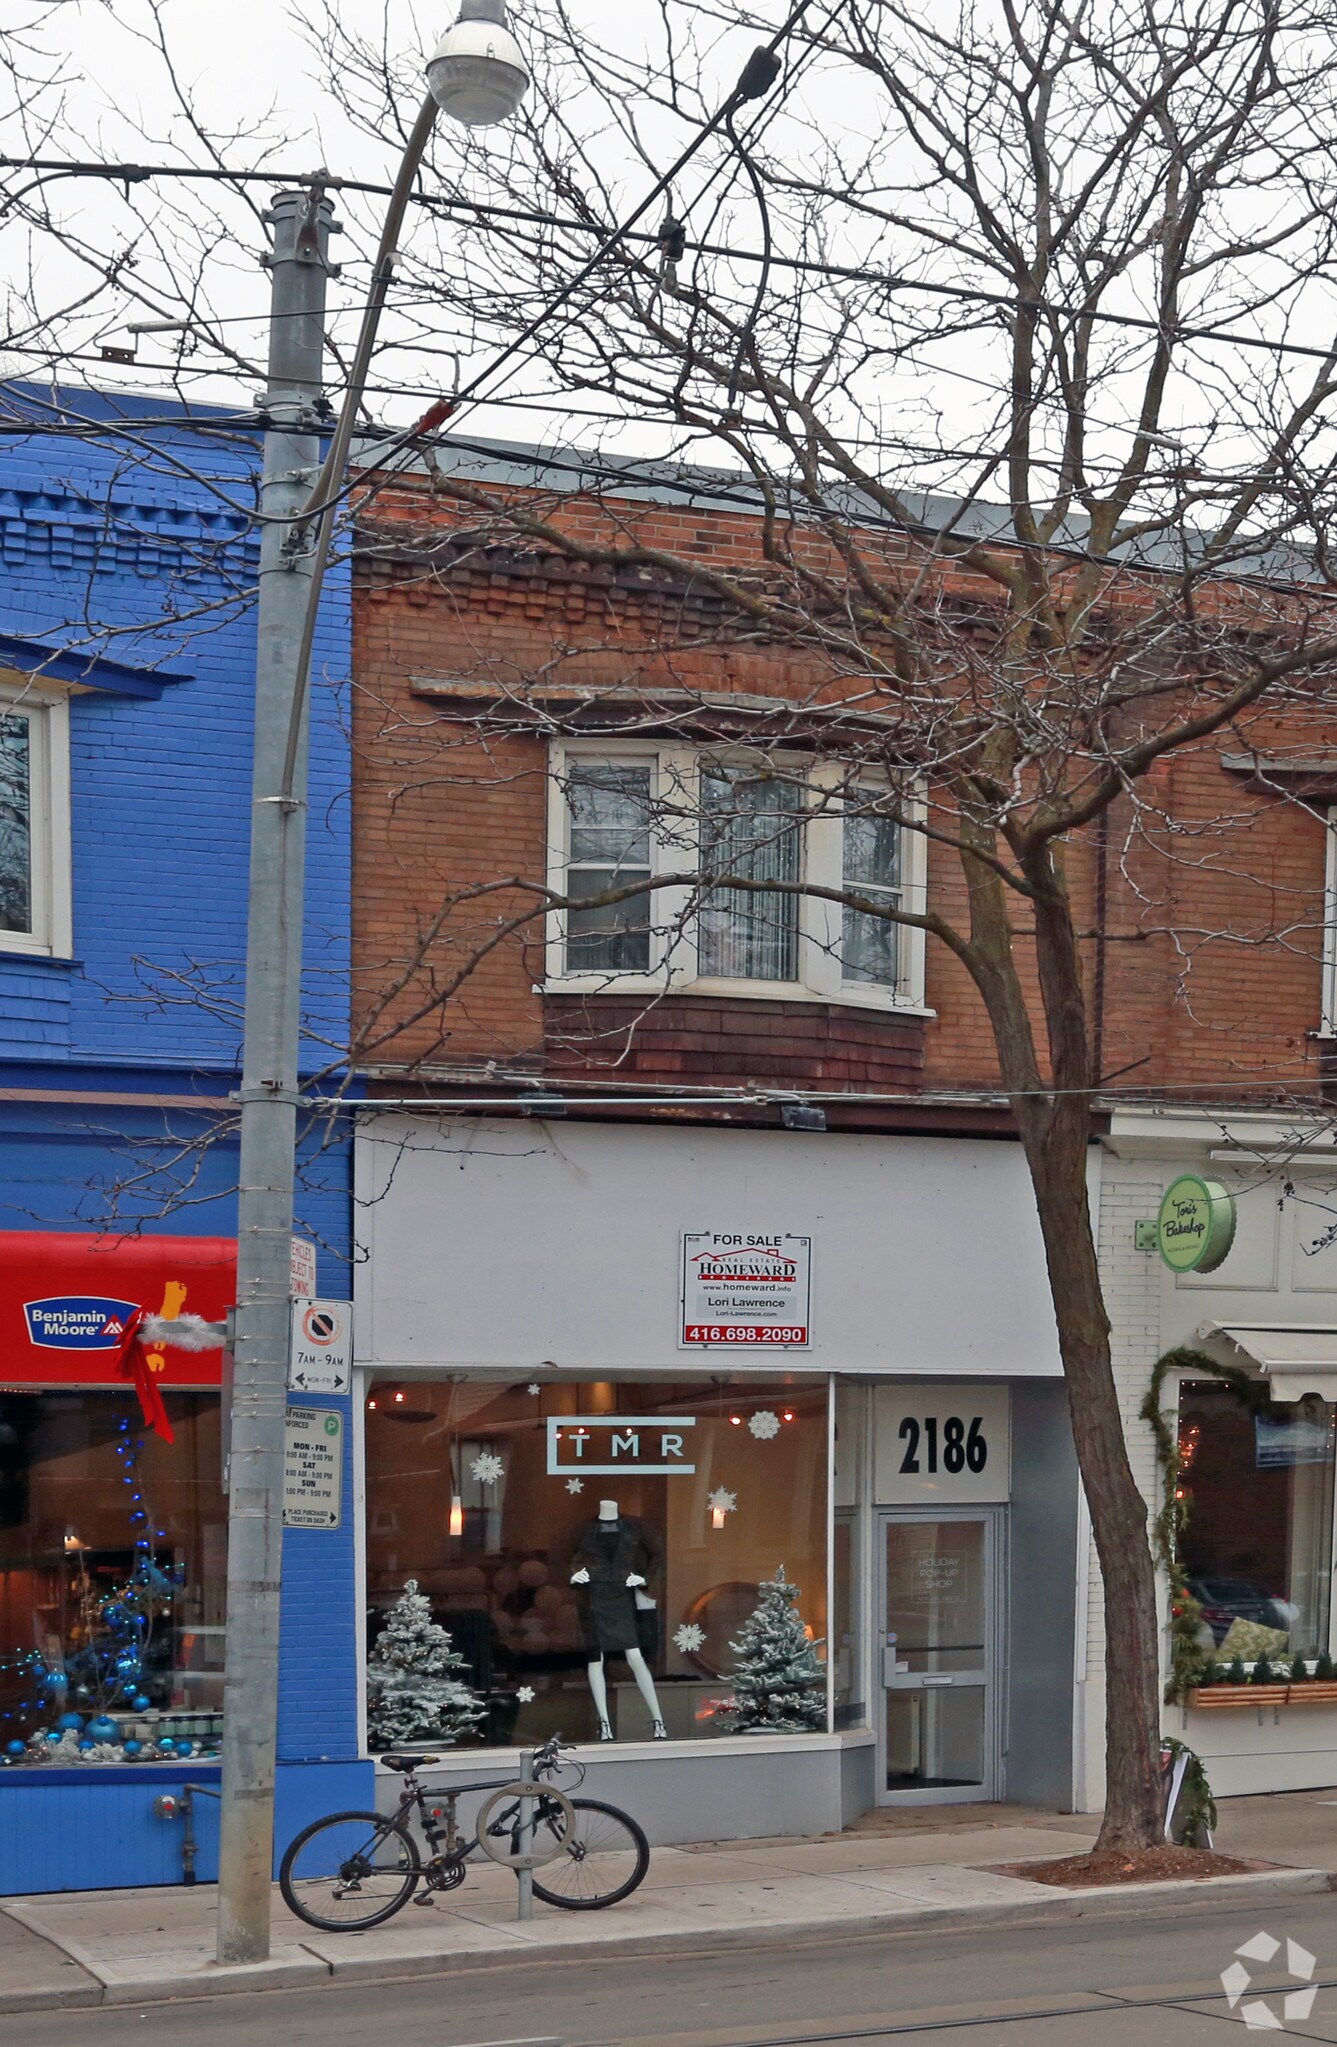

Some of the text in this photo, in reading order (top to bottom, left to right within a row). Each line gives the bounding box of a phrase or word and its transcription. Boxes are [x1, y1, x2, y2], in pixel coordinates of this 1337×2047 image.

[1163, 1217, 1205, 1238] Bakeshop
[713, 1234, 742, 1245] FOR
[746, 1235, 782, 1247] SALE
[290, 1242, 311, 1262] EHICLES
[290, 1260, 306, 1277] BJECT
[700, 1262, 796, 1276] HOMEWARD
[703, 1283, 792, 1292] www.homeward.info
[708, 1297, 786, 1308] Lori Lawrence
[32, 1309, 107, 1325] Benjamin
[44, 1323, 96, 1335] Moore
[690, 1327, 802, 1341] 416.698.2090
[298, 1352, 316, 1364] 7AM
[325, 1354, 343, 1366] 9AM
[292, 1411, 316, 1421] PARKING
[285, 1420, 309, 1429] NFORCED
[293, 1442, 310, 1450] MON
[315, 1444, 327, 1452] FRI
[899, 1416, 988, 1474] 2186
[324, 1454, 334, 1462] PM
[302, 1461, 316, 1469] SAT
[323, 1472, 333, 1480] PM
[296, 1488, 306, 1496] PM
[322, 1490, 331, 1498] PM
[919, 1558, 959, 1567] HOLIDAY
[920, 1569, 958, 1577] POP-UP
[925, 1579, 953, 1588] SHOP
